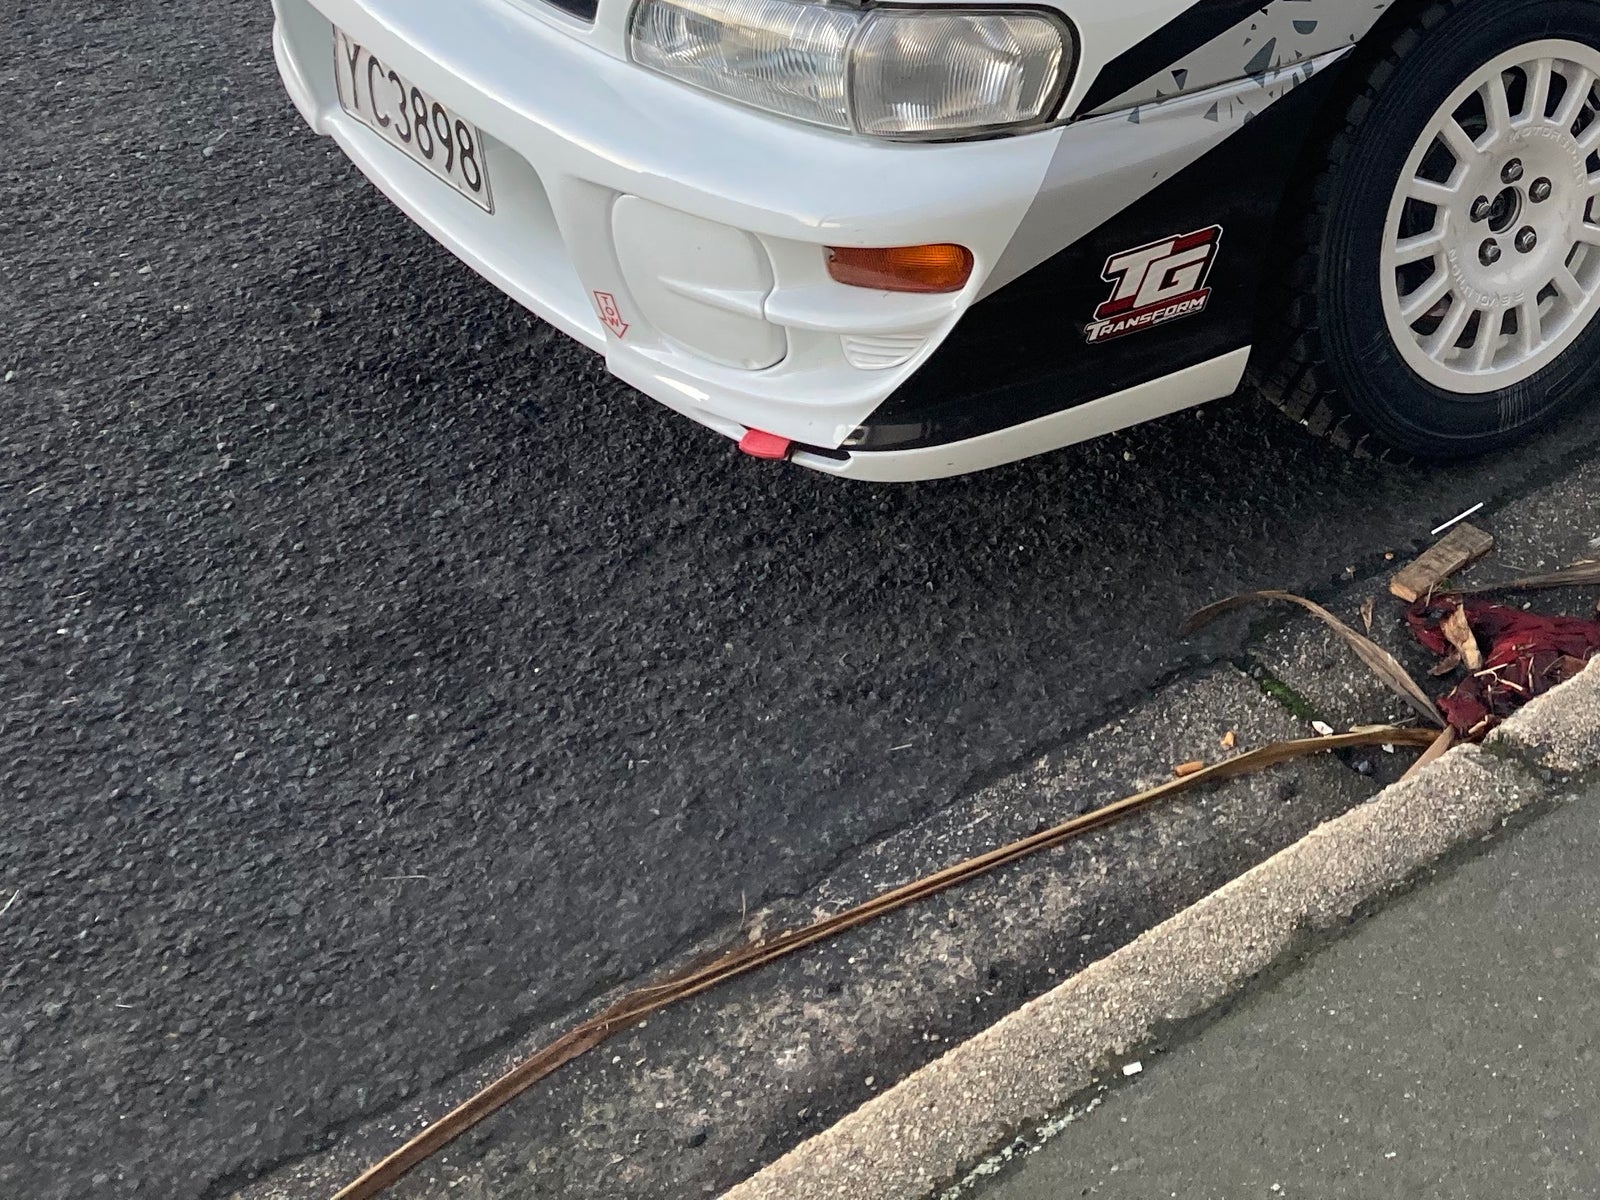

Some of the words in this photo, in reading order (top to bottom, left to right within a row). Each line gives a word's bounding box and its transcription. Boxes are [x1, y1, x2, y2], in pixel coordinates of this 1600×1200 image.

[341, 31, 482, 193] YC3898
[1107, 239, 1212, 309] TG
[600, 295, 620, 328] TOW
